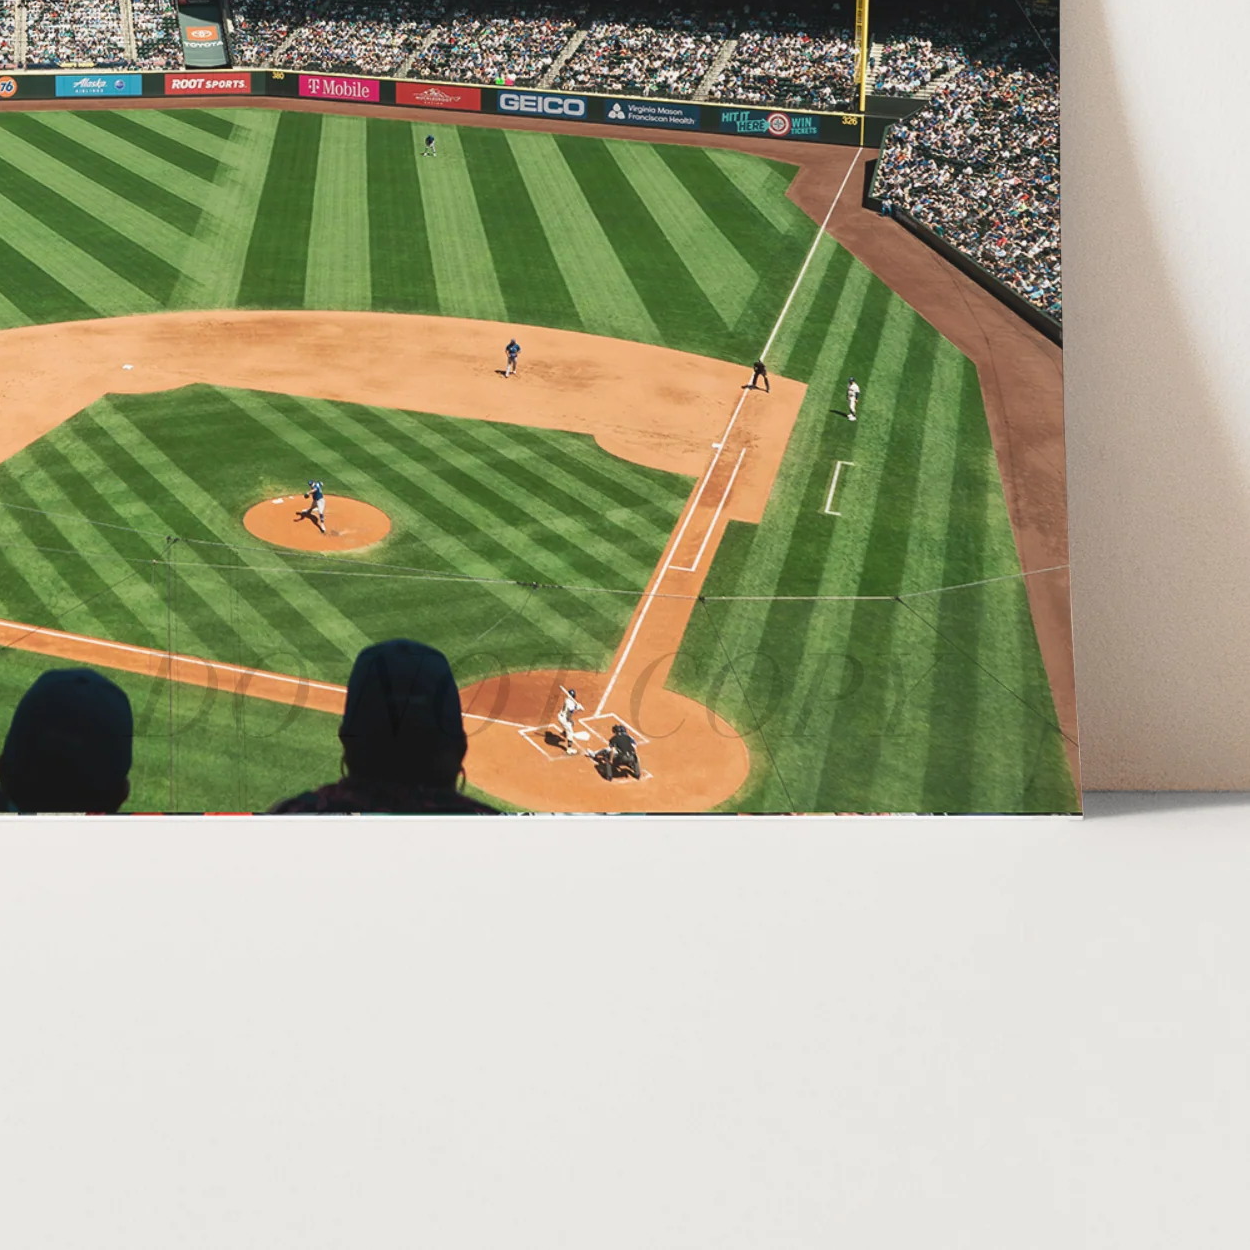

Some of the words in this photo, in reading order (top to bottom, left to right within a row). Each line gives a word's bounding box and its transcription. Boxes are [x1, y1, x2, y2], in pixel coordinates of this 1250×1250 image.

[183, 40, 224, 49] TOYOTA
[73, 78, 107, 90] Alaska
[171, 78, 205, 91] ROOT
[205, 79, 245, 90] SPORTS
[308, 78, 320, 94] T
[323, 79, 370, 98] Mobile
[499, 93, 586, 116] GEICO
[627, 104, 656, 115] Virginia
[657, 106, 683, 116] Mason
[627, 112, 667, 123] Franciscan
[668, 115, 694, 126] Health
[721, 111, 738, 124] HIT
[738, 111, 750, 123] IT
[791, 117, 813, 128] WIN
[841, 116, 859, 127] 326
[738, 120, 765, 132] HERE
[791, 127, 817, 135] TICKETS
